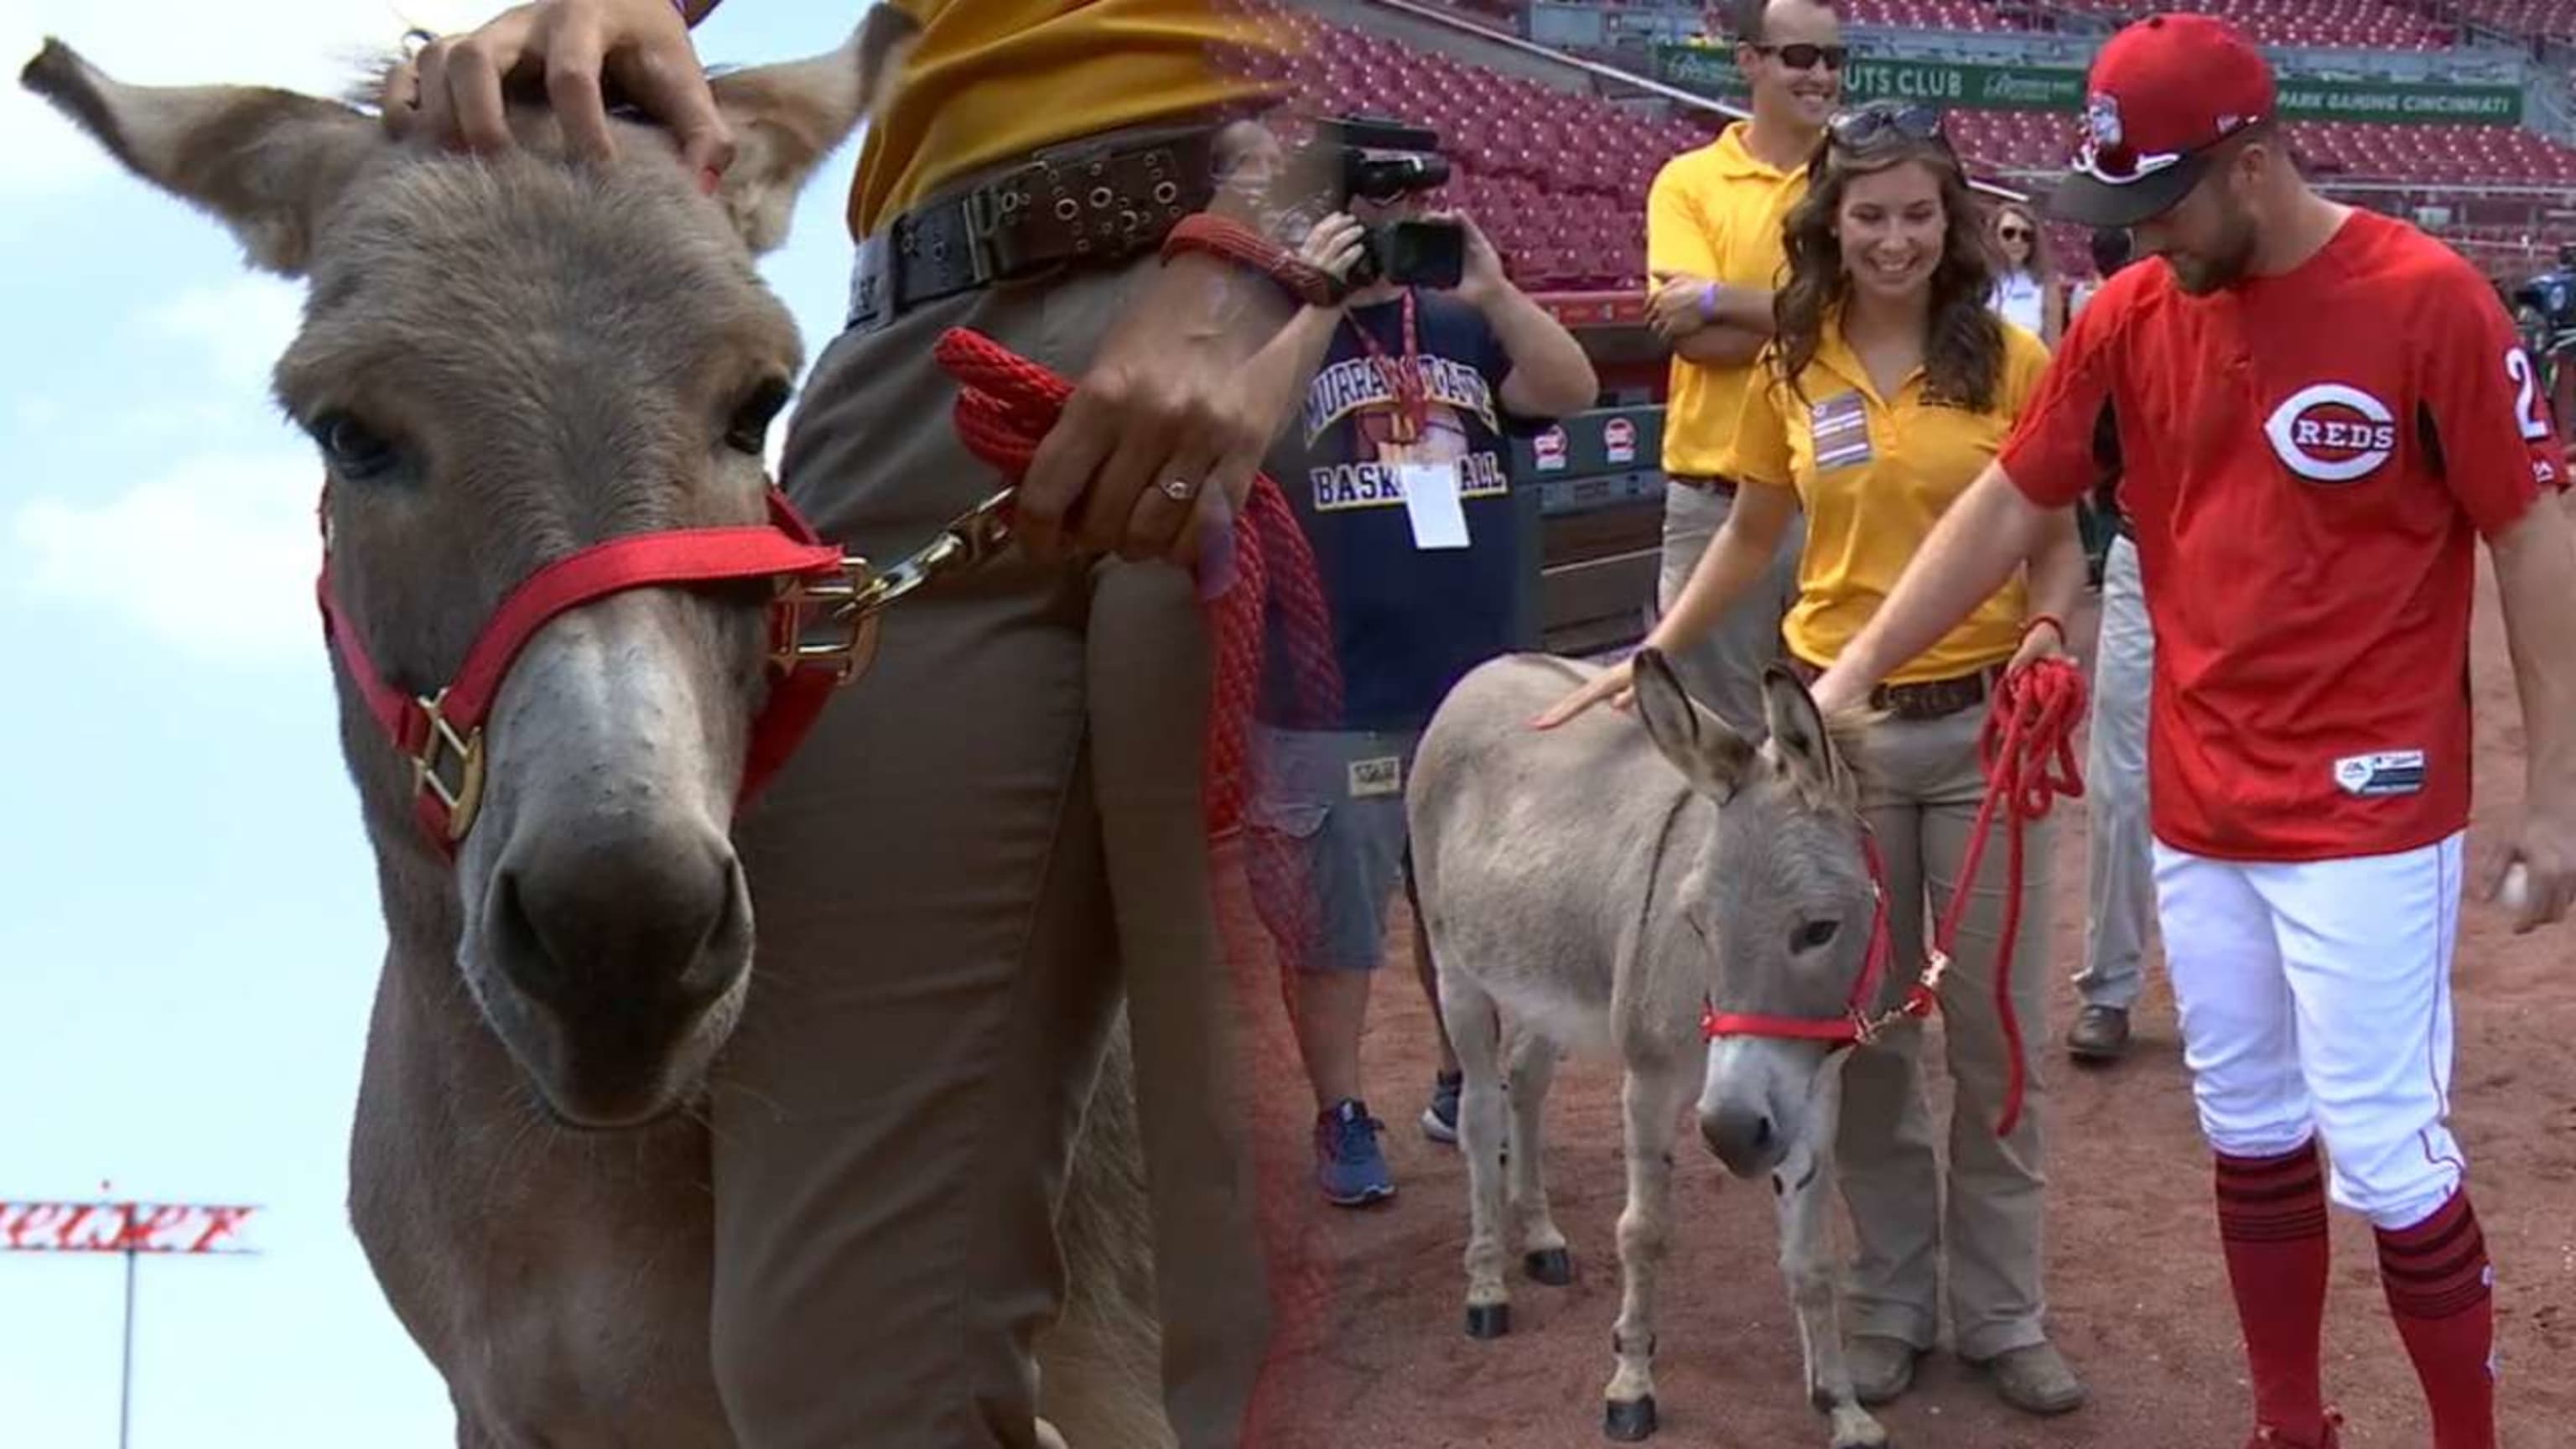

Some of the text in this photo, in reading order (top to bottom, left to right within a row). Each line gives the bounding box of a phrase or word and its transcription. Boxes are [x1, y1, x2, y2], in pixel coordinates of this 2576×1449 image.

[1897, 68, 1963, 97] CLUB
[2402, 94, 2510, 114] CINCINNATI
[2295, 420, 2396, 449] REDS
[1310, 451, 1508, 511] BASKALL
[0, 1180, 252, 1252] eiser
